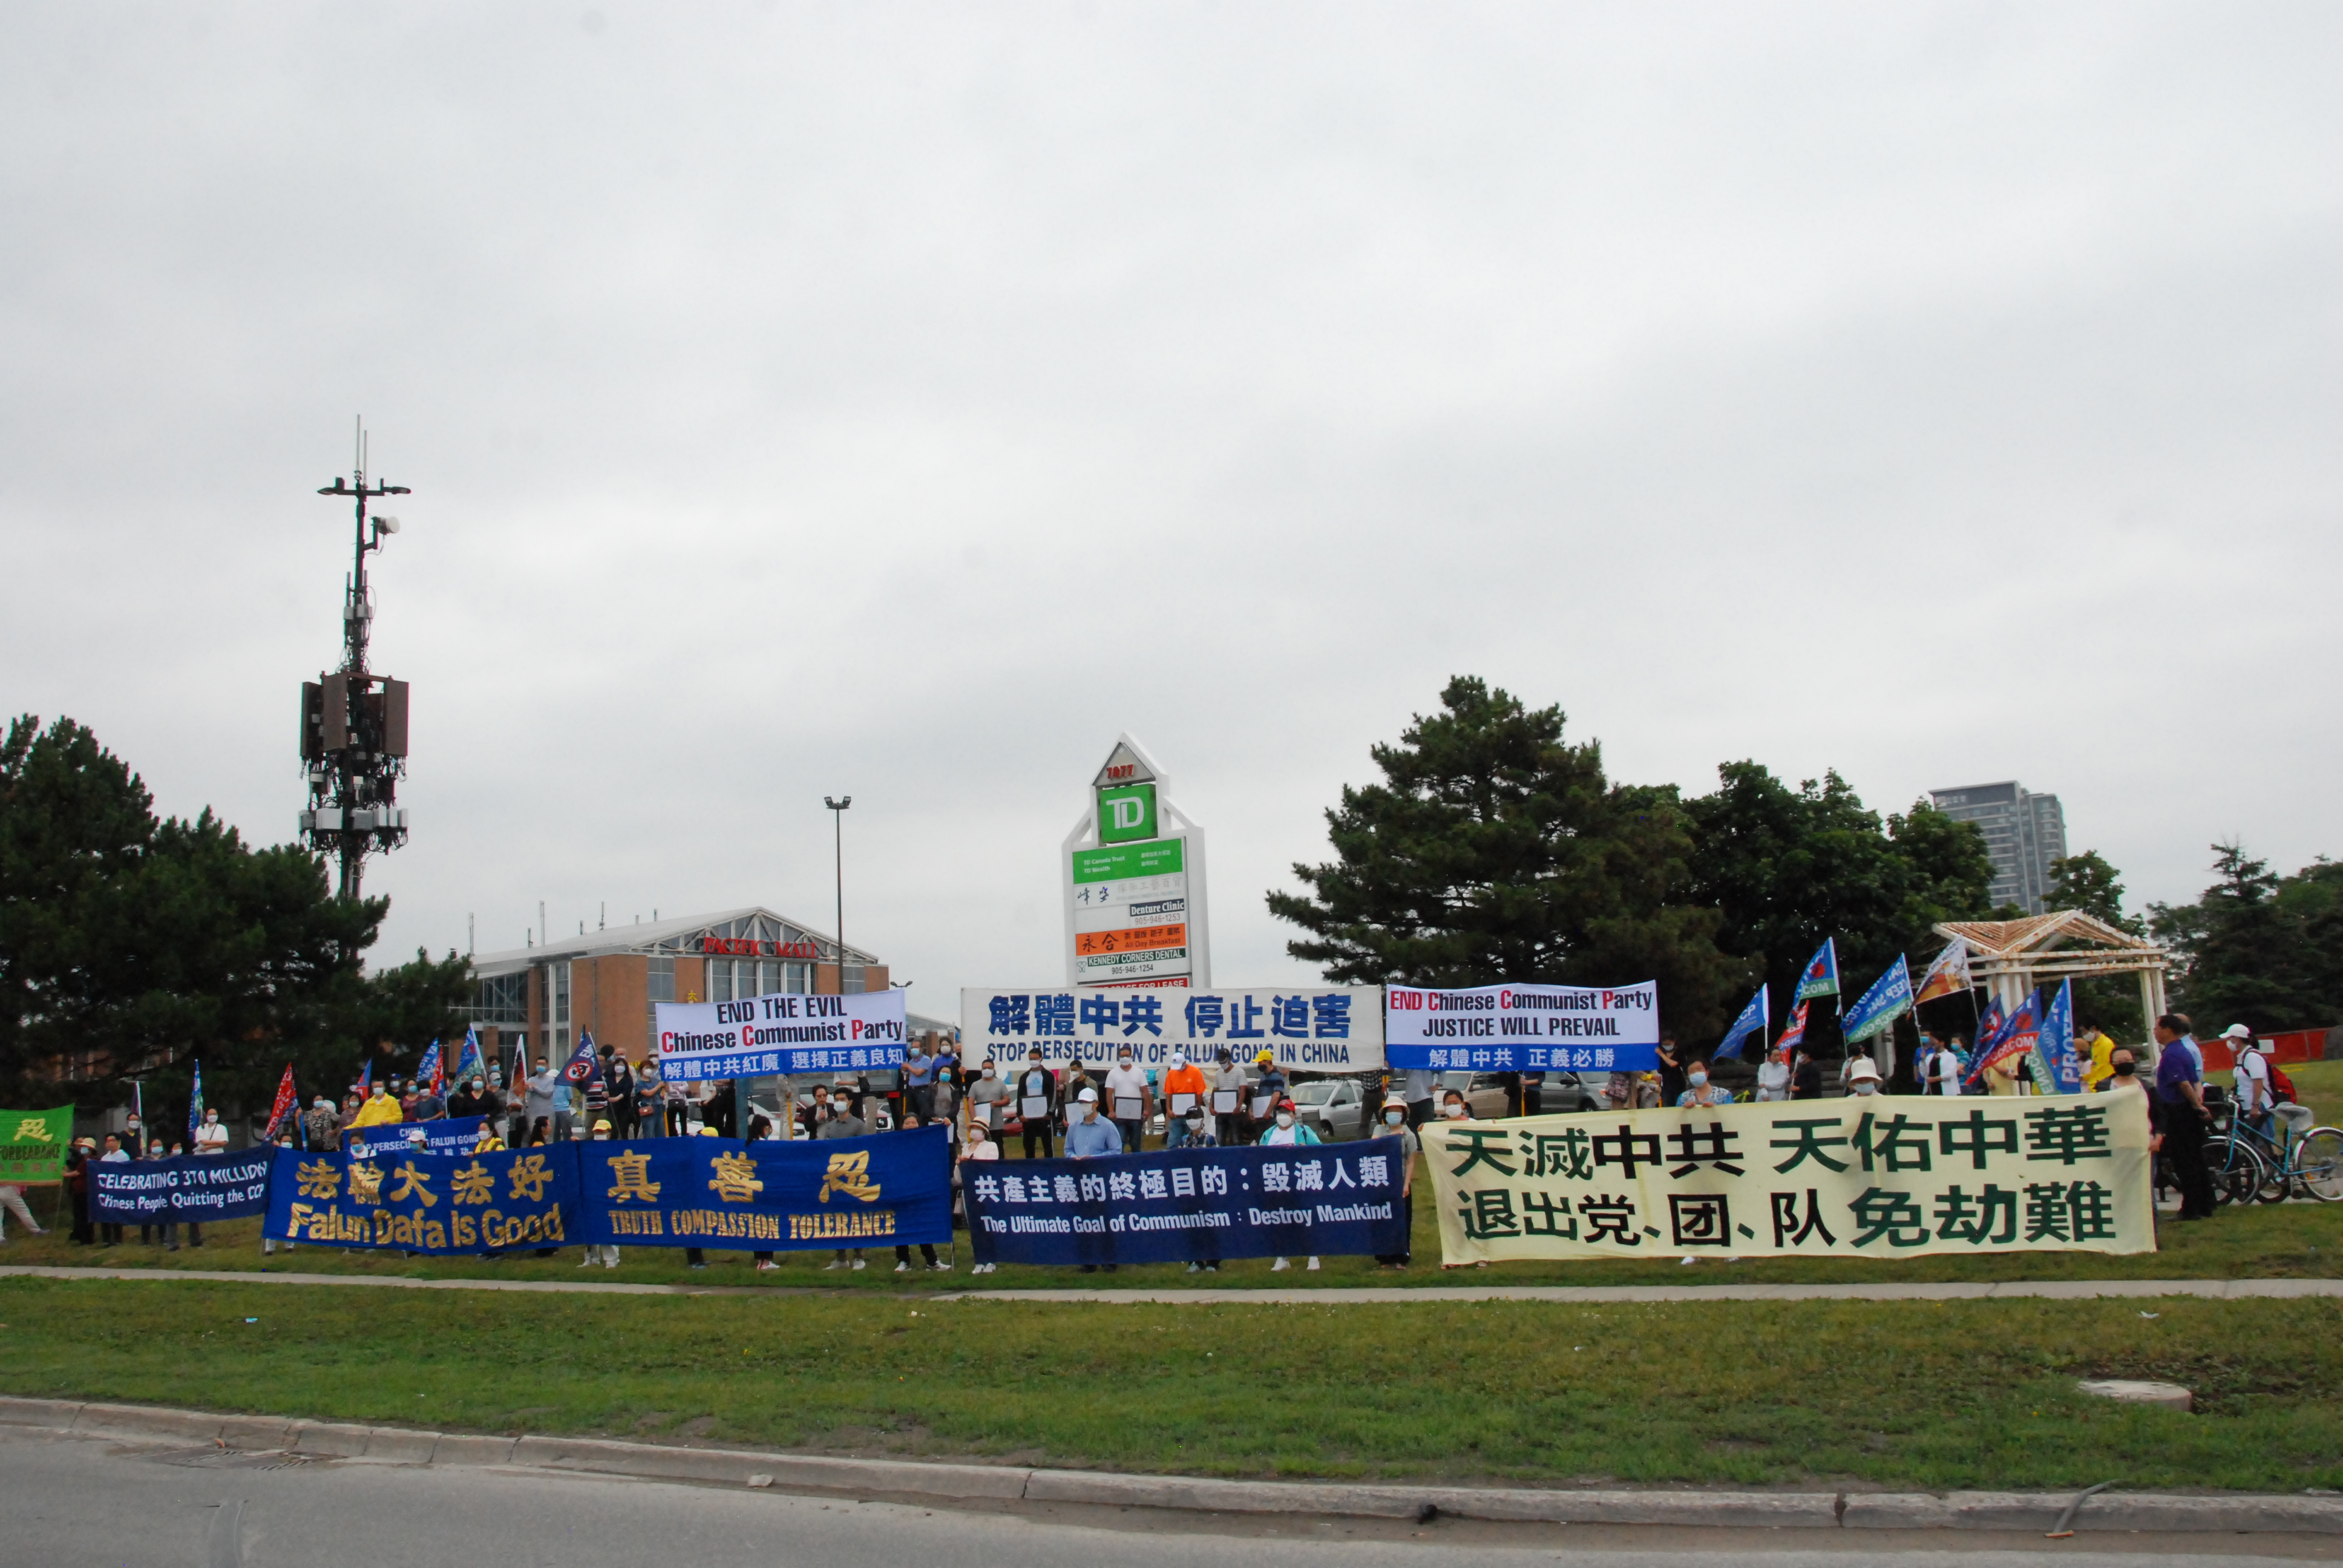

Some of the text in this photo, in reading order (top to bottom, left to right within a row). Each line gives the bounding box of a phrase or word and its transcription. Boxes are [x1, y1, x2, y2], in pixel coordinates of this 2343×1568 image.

[1106, 797, 1144, 829] TD
[1131, 901, 1184, 915] Denture Clinic
[1135, 913, 1181, 925] 905-946-1253
[704, 936, 819, 958] PACIFIC MALL
[1089, 949, 1182, 965] KENNEDY CORNERS DENTAL
[1112, 964, 1153, 974] 905-946-1254
[716, 996, 847, 1024] END THE EVIL
[1391, 990, 1652, 1011] END Chinese Communist Party
[988, 993, 1351, 1039] 解體中共 停止迫害
[1423, 1017, 1620, 1037] JUSTICE WILL PREVAIL
[661, 1019, 903, 1053] Chinese Communist Party
[663, 1047, 904, 1079] 解體中共紅魔 選擇正義良知
[988, 1042, 1027, 1062] STOP
[1149, 1044, 1168, 1063] OF
[1280, 1044, 1296, 1063] IN
[1302, 1044, 1350, 1064] CHINA
[1429, 1048, 1615, 1067] 解體中共 正義必勝
[431, 1137, 456, 1146] FALUN
[457, 1134, 479, 1144] GONG
[1446, 1105, 2112, 1181] 天滅中共 天佑中華
[97, 1160, 267, 1190] CELEBRATING 370 MILLION
[295, 1154, 554, 1207] 法輪大法好
[607, 1149, 881, 1203] 真 善 忍
[98, 1183, 264, 1212] Chinese People Quitting the CCP
[287, 1202, 565, 1248] Falun Dafa Is Good
[608, 1209, 896, 1240] TRUTH COMPASSION TOLERANCE
[981, 1216, 1006, 1233] The
[1010, 1216, 1070, 1233] Ultimate
[1072, 1215, 1106, 1233] Goal
[1110, 1214, 1126, 1232] of
[1129, 1210, 1230, 1231] Communism
[1249, 1207, 1312, 1227] Destroy
[1316, 1201, 1392, 1222] Mankind
